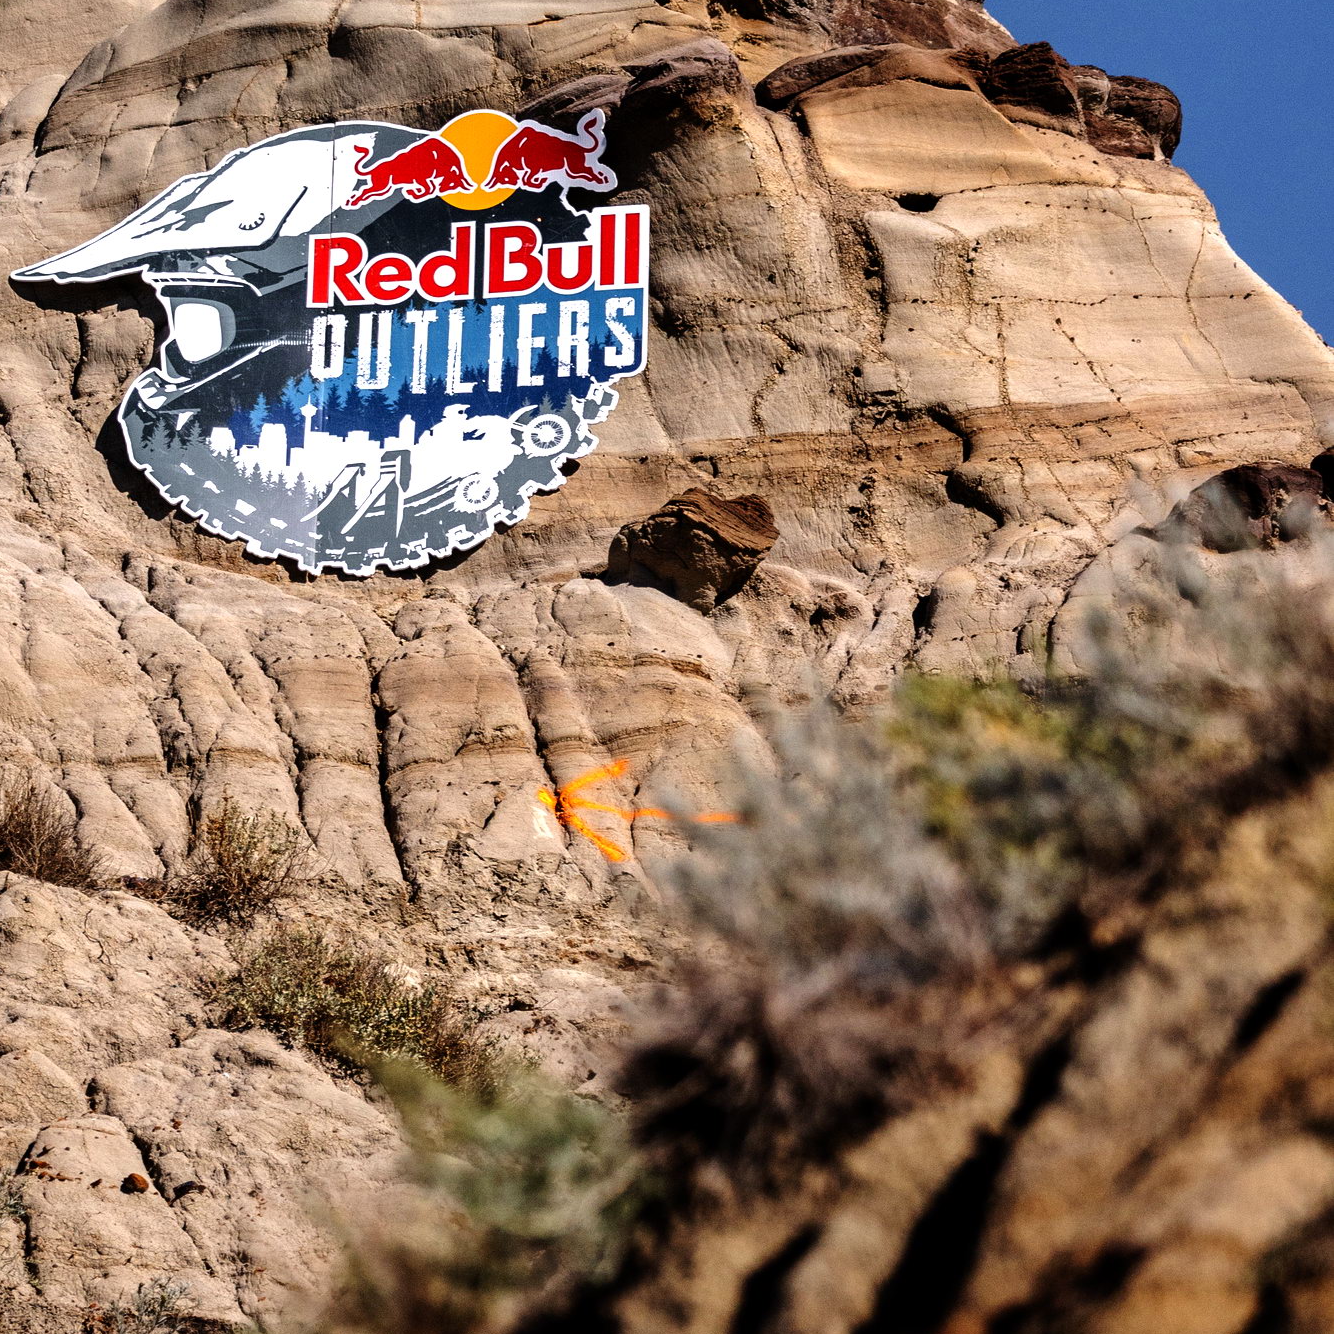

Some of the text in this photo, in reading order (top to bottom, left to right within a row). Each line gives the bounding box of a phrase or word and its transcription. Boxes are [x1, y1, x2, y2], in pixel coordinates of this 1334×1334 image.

[311, 212, 641, 305] Red Bull
[309, 297, 636, 394] OUTLIERS
